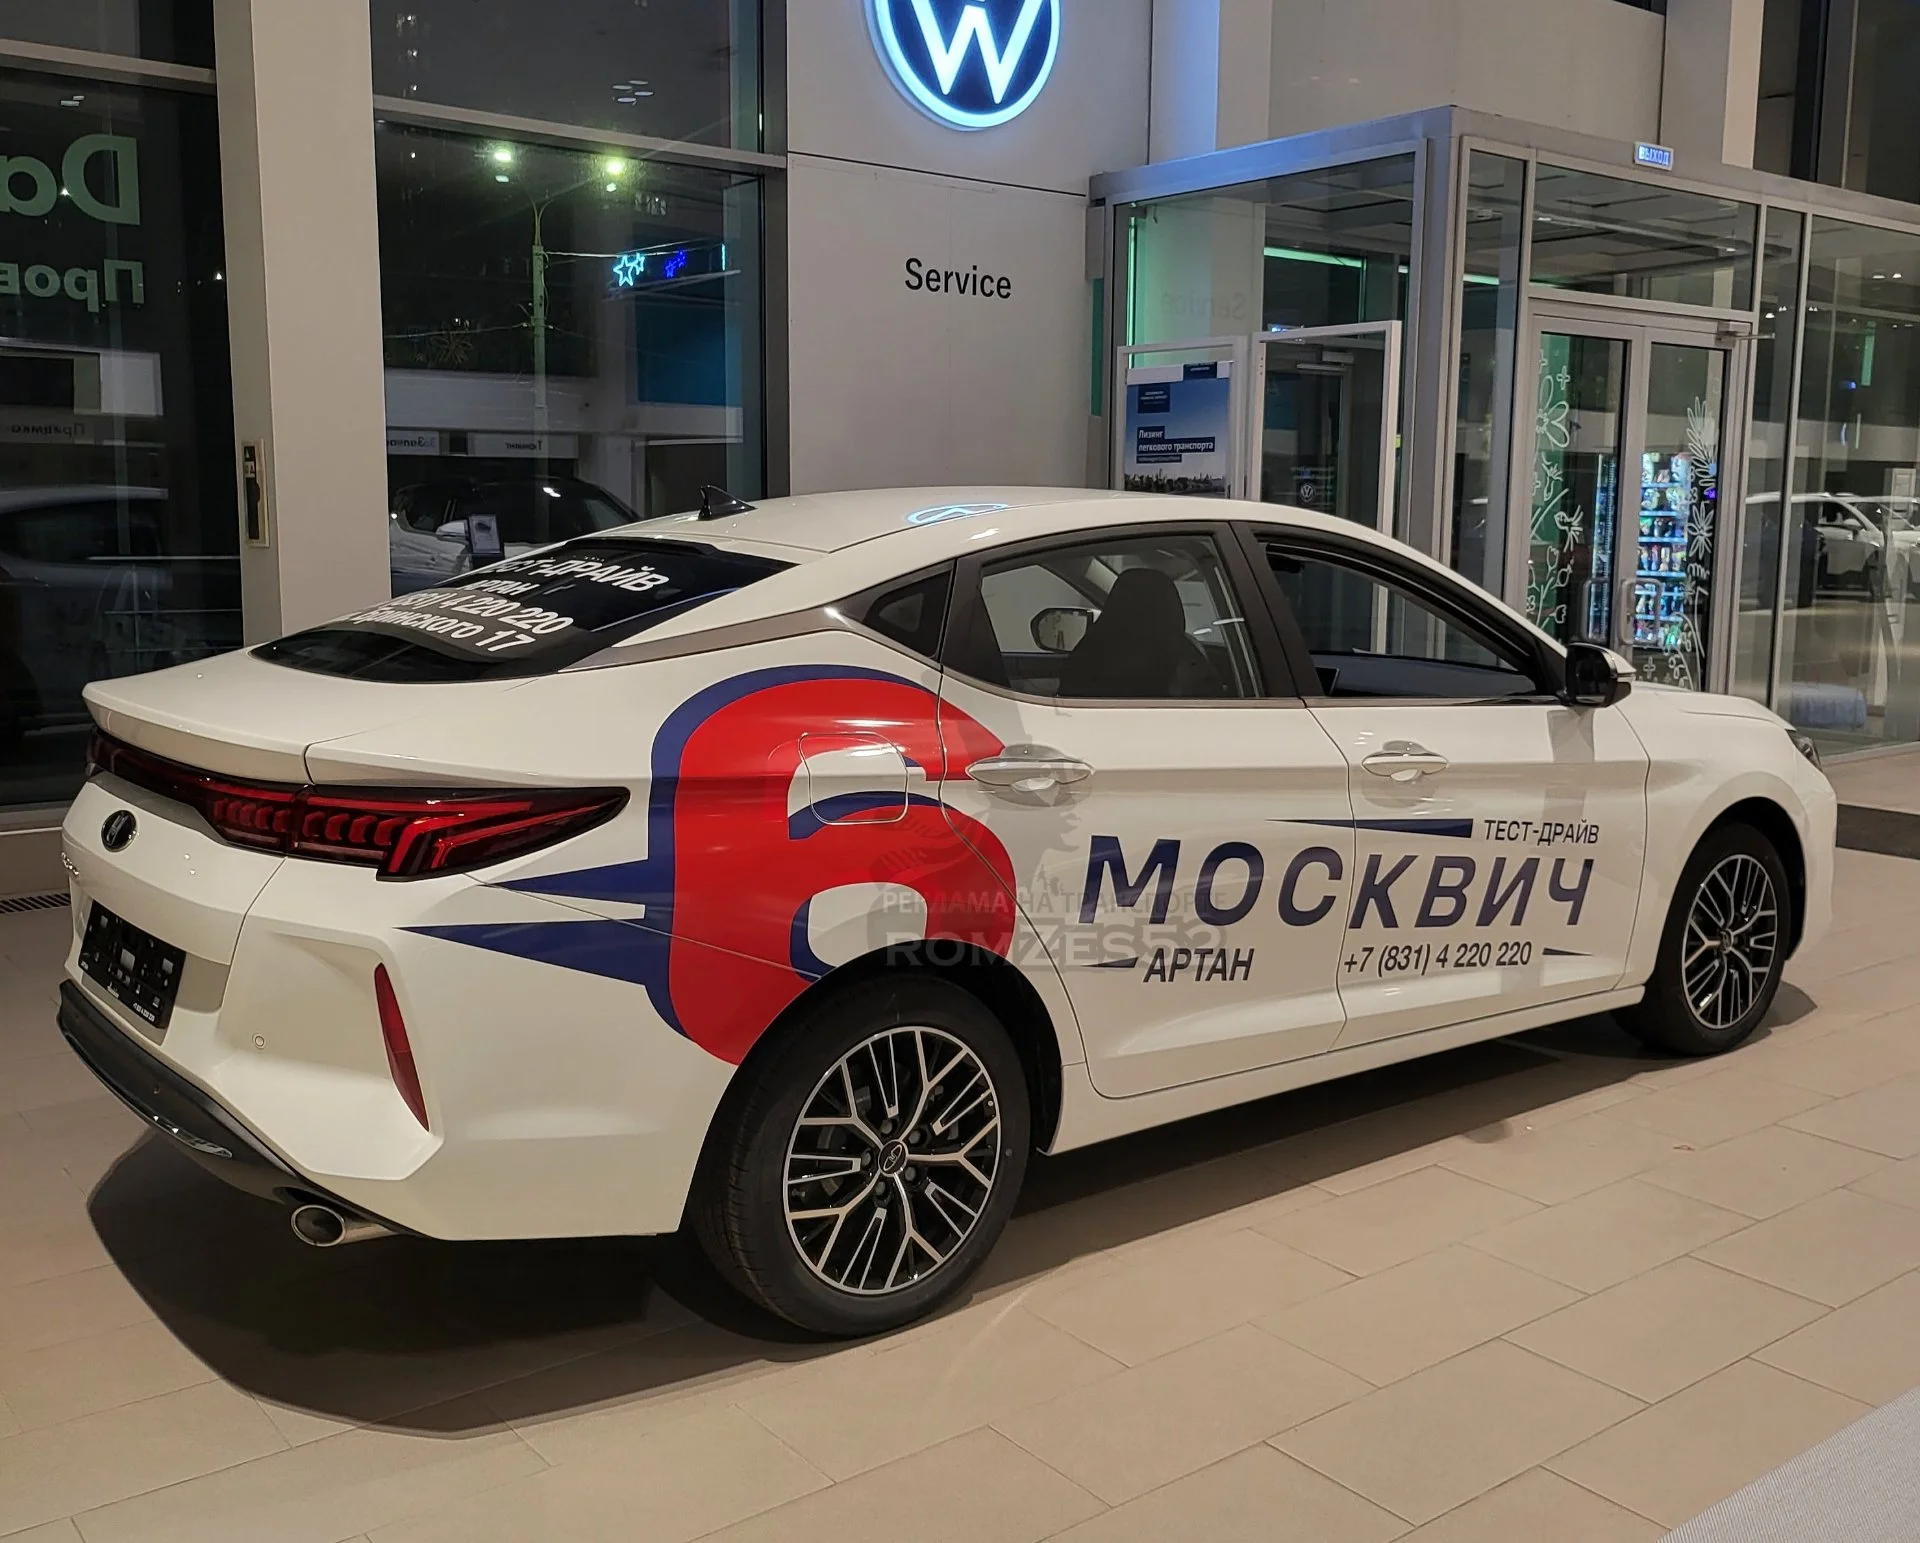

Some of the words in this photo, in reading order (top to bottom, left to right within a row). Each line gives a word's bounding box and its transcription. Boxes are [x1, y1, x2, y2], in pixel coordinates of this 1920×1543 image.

[1639, 145, 1670, 166] ВЫХОД
[904, 257, 1012, 300] Service
[1138, 429, 1164, 440] Лизинг
[1173, 441, 1214, 453] транспорта
[451, 596, 521, 617] 220
[498, 608, 574, 635] 220
[475, 630, 537, 652] 17
[1484, 819, 1600, 846] ТЕСТ-ДРАЙВ
[1078, 834, 1595, 929] МОСКВИЧ
[1143, 947, 1255, 983] АРТАН
[1343, 947, 1374, 974] +7
[1378, 944, 1431, 978] (831)
[1435, 944, 1449, 969] 4
[1453, 942, 1492, 968] 220
[1496, 941, 1533, 966] 220
